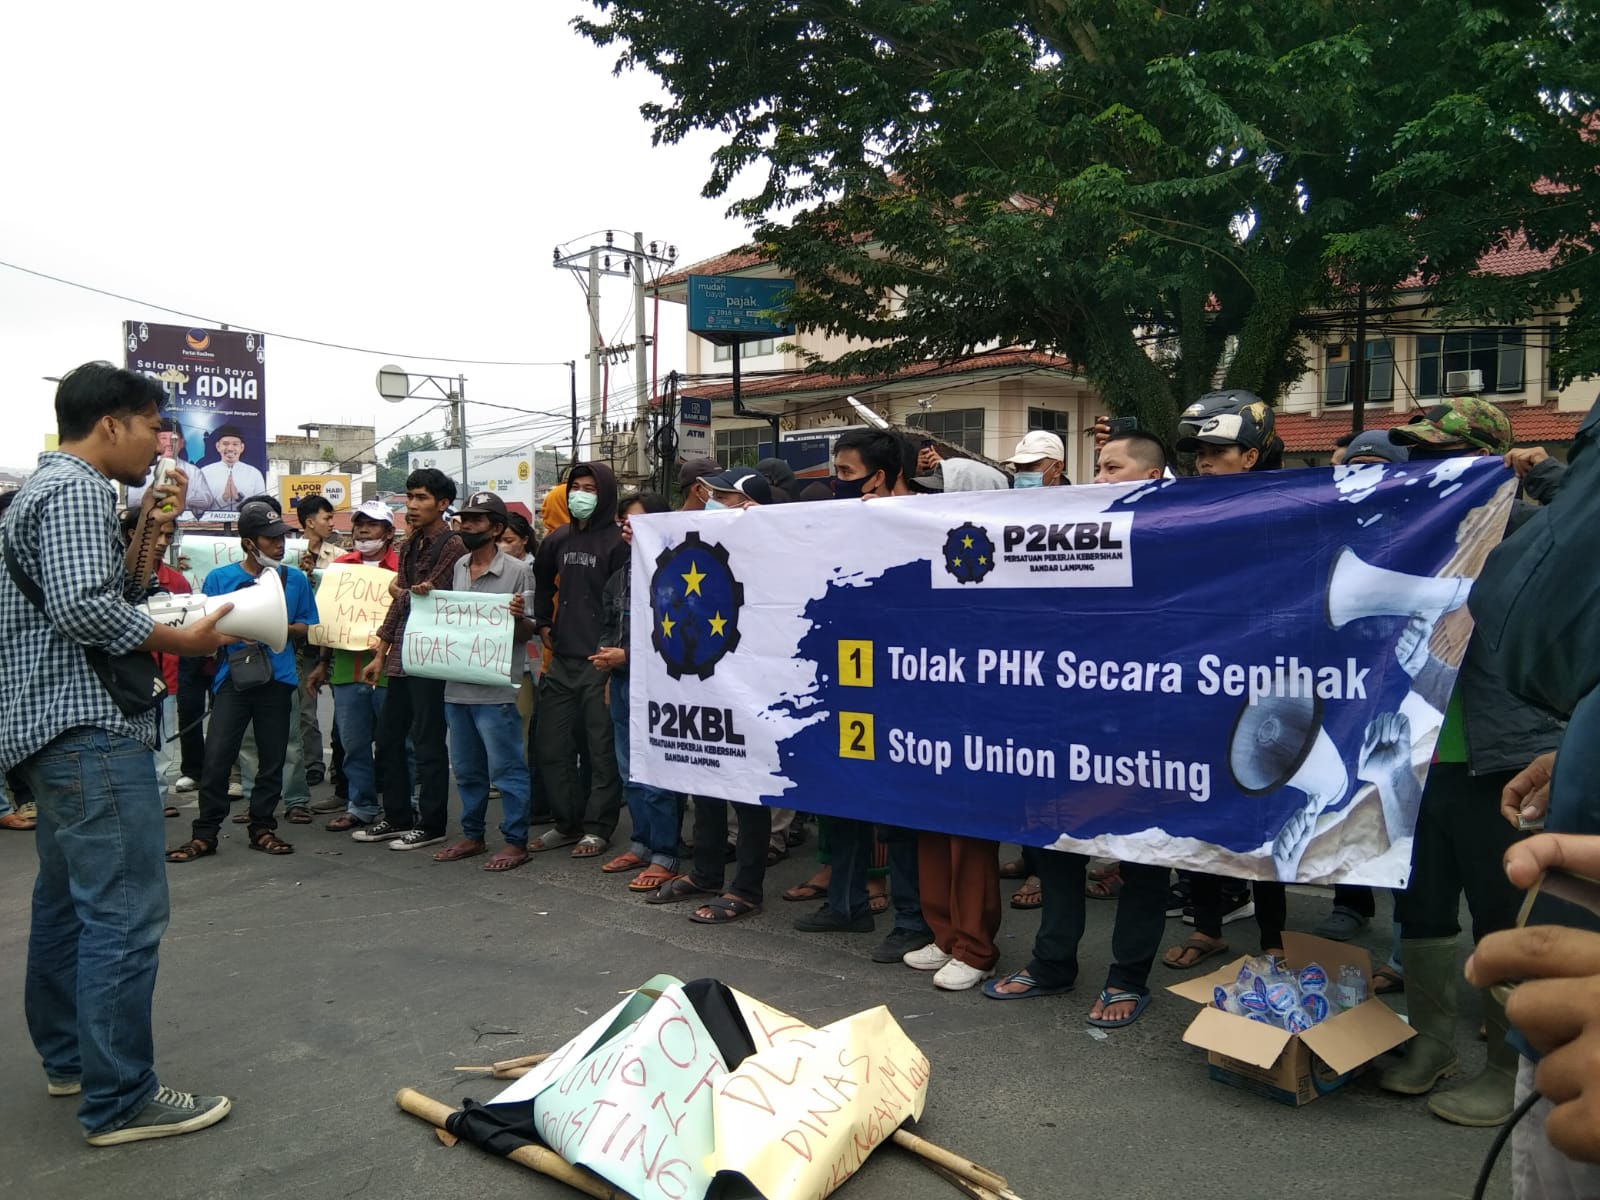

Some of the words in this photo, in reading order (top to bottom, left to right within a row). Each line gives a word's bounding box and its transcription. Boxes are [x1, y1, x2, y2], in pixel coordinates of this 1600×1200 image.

[137, 360, 190, 372] Selamat
[194, 365, 220, 374] Hari
[224, 367, 254, 378] Raya
[196, 375, 258, 400] ADHA
[180, 398, 217, 407] 1443H
[687, 429, 705, 438] ATM
[1003, 522, 1123, 552] P2KBL
[1003, 554, 1043, 563] PERSATUAN
[1043, 553, 1076, 561] PEKERJA
[1076, 552, 1123, 560] KEBERSIHAN
[1029, 564, 1059, 573] BANDAR
[1059, 563, 1095, 571] LAMPUNG
[434, 597, 511, 632] PEMKOT
[314, 624, 352, 645] DLH
[468, 633, 512, 678] ADIL
[850, 648, 862, 679] 1
[887, 647, 966, 682] Tolak
[977, 649, 1046, 687] PHK
[1056, 651, 1183, 693] Secara
[1197, 654, 1371, 706] Sepihak
[648, 700, 746, 746] P2KBL
[664, 752, 690, 763] BANDAR
[690, 756, 721, 768] LAMPUNG
[677, 741, 703, 753] PEKERJA
[704, 744, 747, 759] KEBERSIHAN
[850, 720, 866, 752] 2
[888, 728, 952, 775] Stop
[964, 735, 1056, 778] Union
[1069, 744, 1211, 802] Busting
[781, 1048, 870, 1163] DINAS
